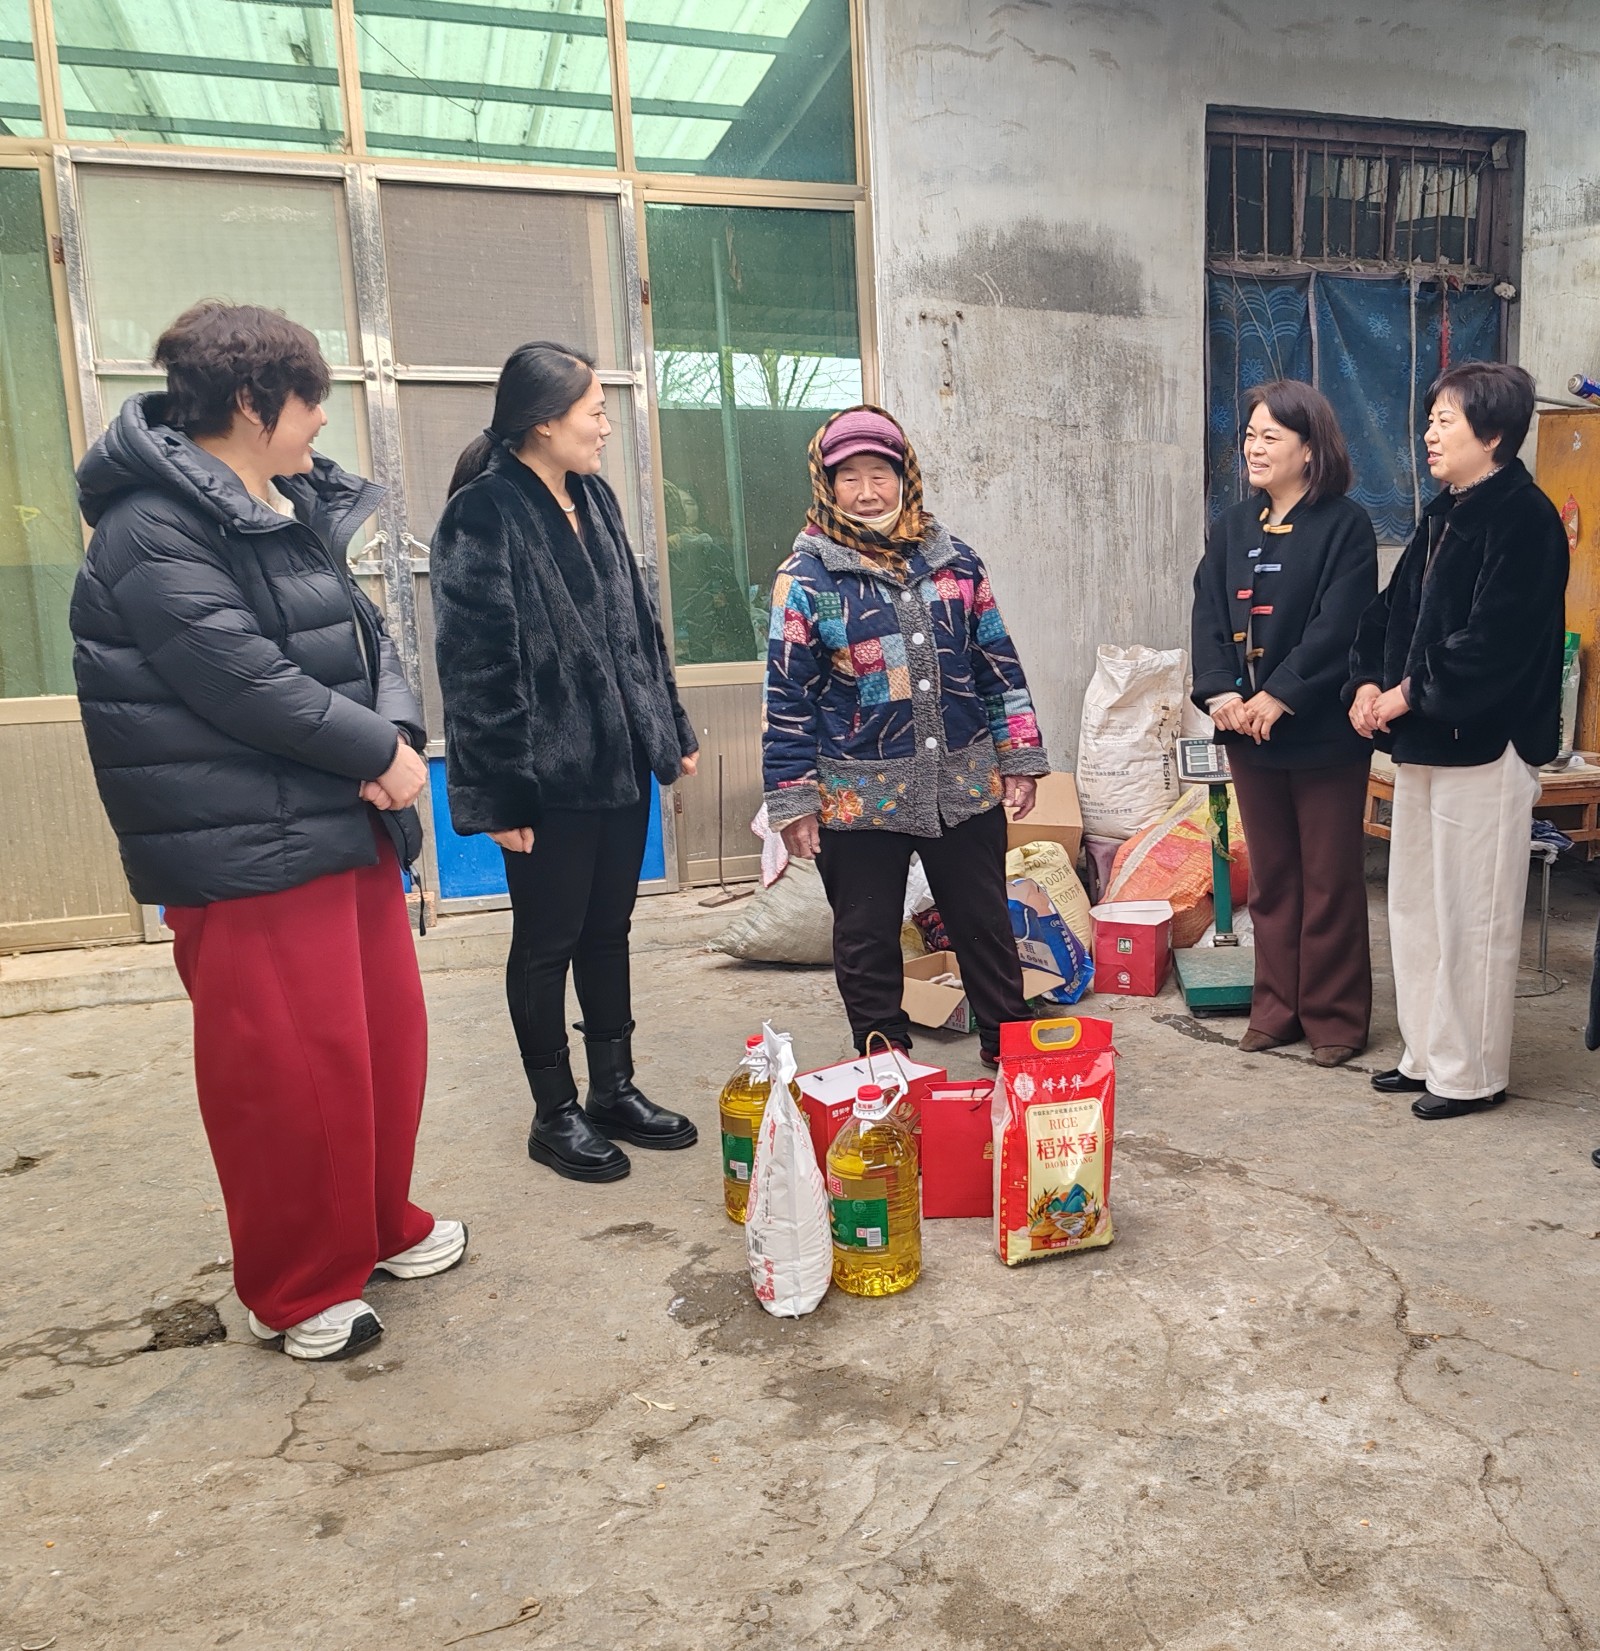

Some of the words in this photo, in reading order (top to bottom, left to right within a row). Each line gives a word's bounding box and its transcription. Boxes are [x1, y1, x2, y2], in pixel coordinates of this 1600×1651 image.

[1162, 753, 1171, 790] RESIN
[1042, 1073, 1083, 1094] 峰丰华
[1049, 1117, 1079, 1130] RICE
[1035, 1131, 1098, 1161] 稻米香
